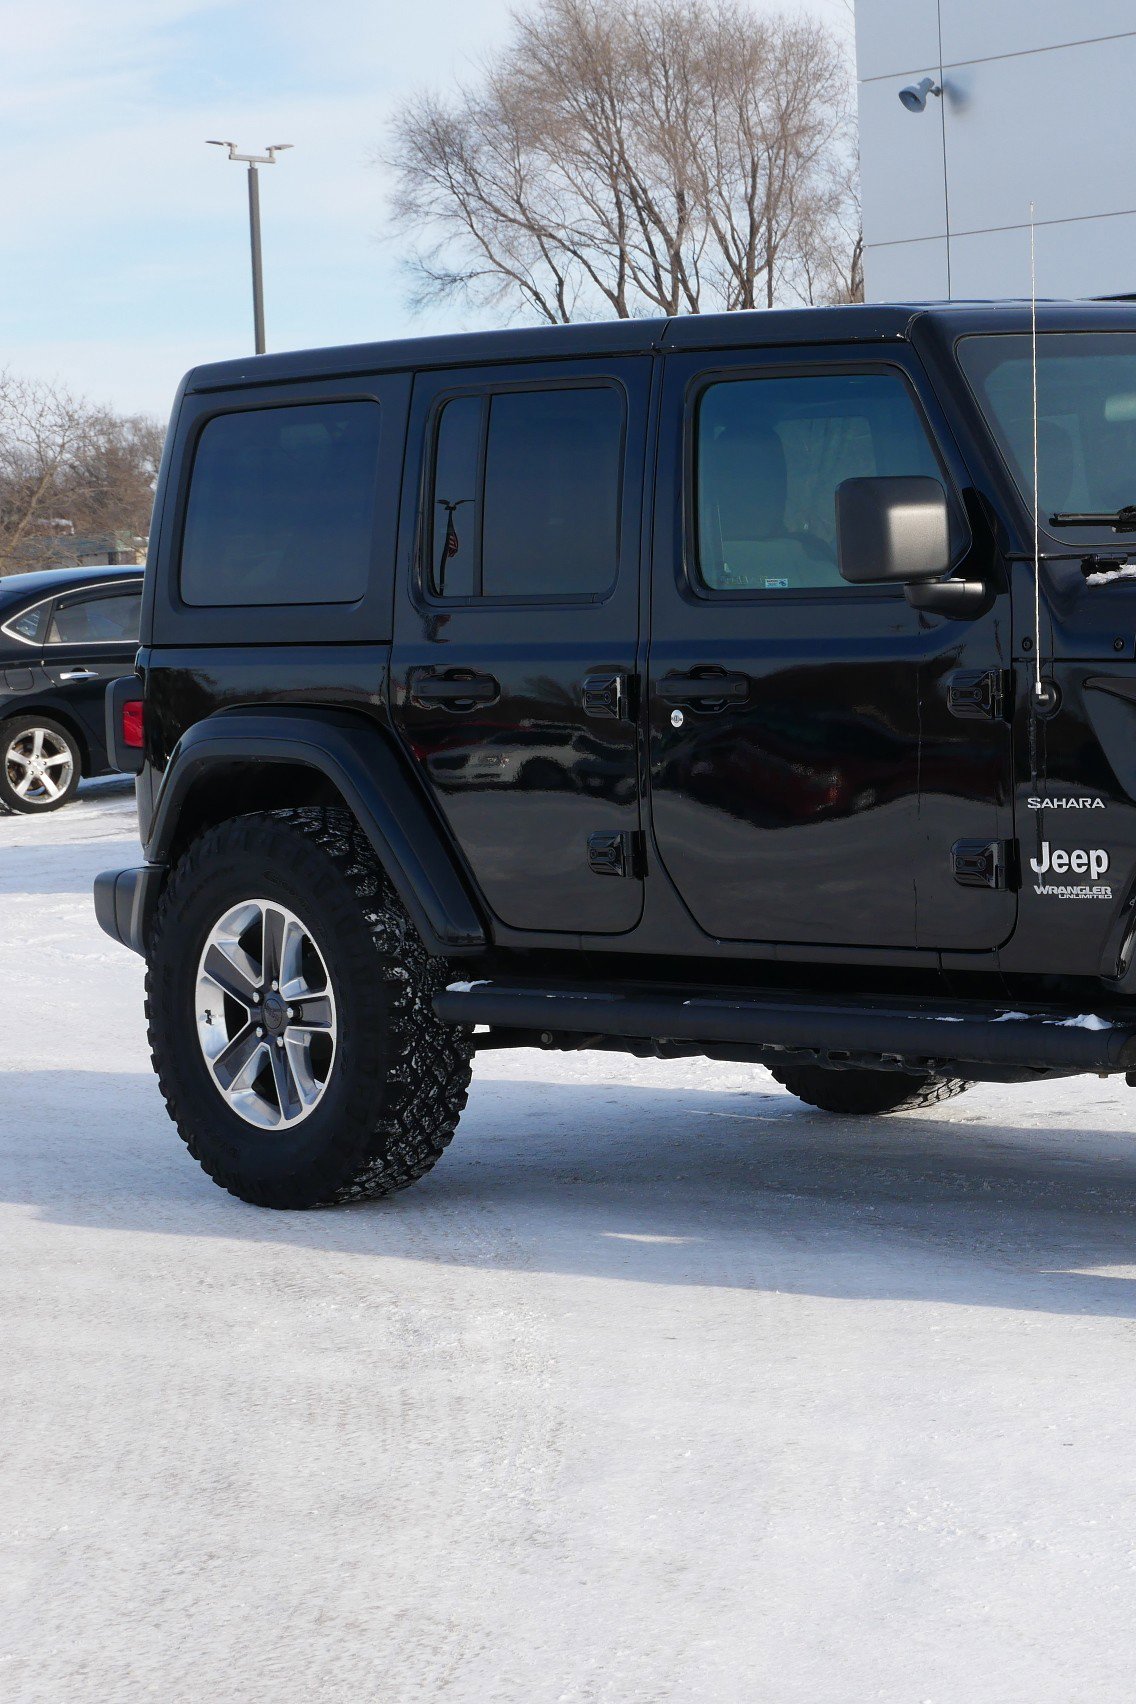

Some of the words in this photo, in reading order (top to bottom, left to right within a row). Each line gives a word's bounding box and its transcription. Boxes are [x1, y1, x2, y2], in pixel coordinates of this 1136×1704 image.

[1027, 797, 1106, 809] SAHARA
[1030, 841, 1109, 880] Jeep
[1034, 885, 1112, 895] WRANGLER
